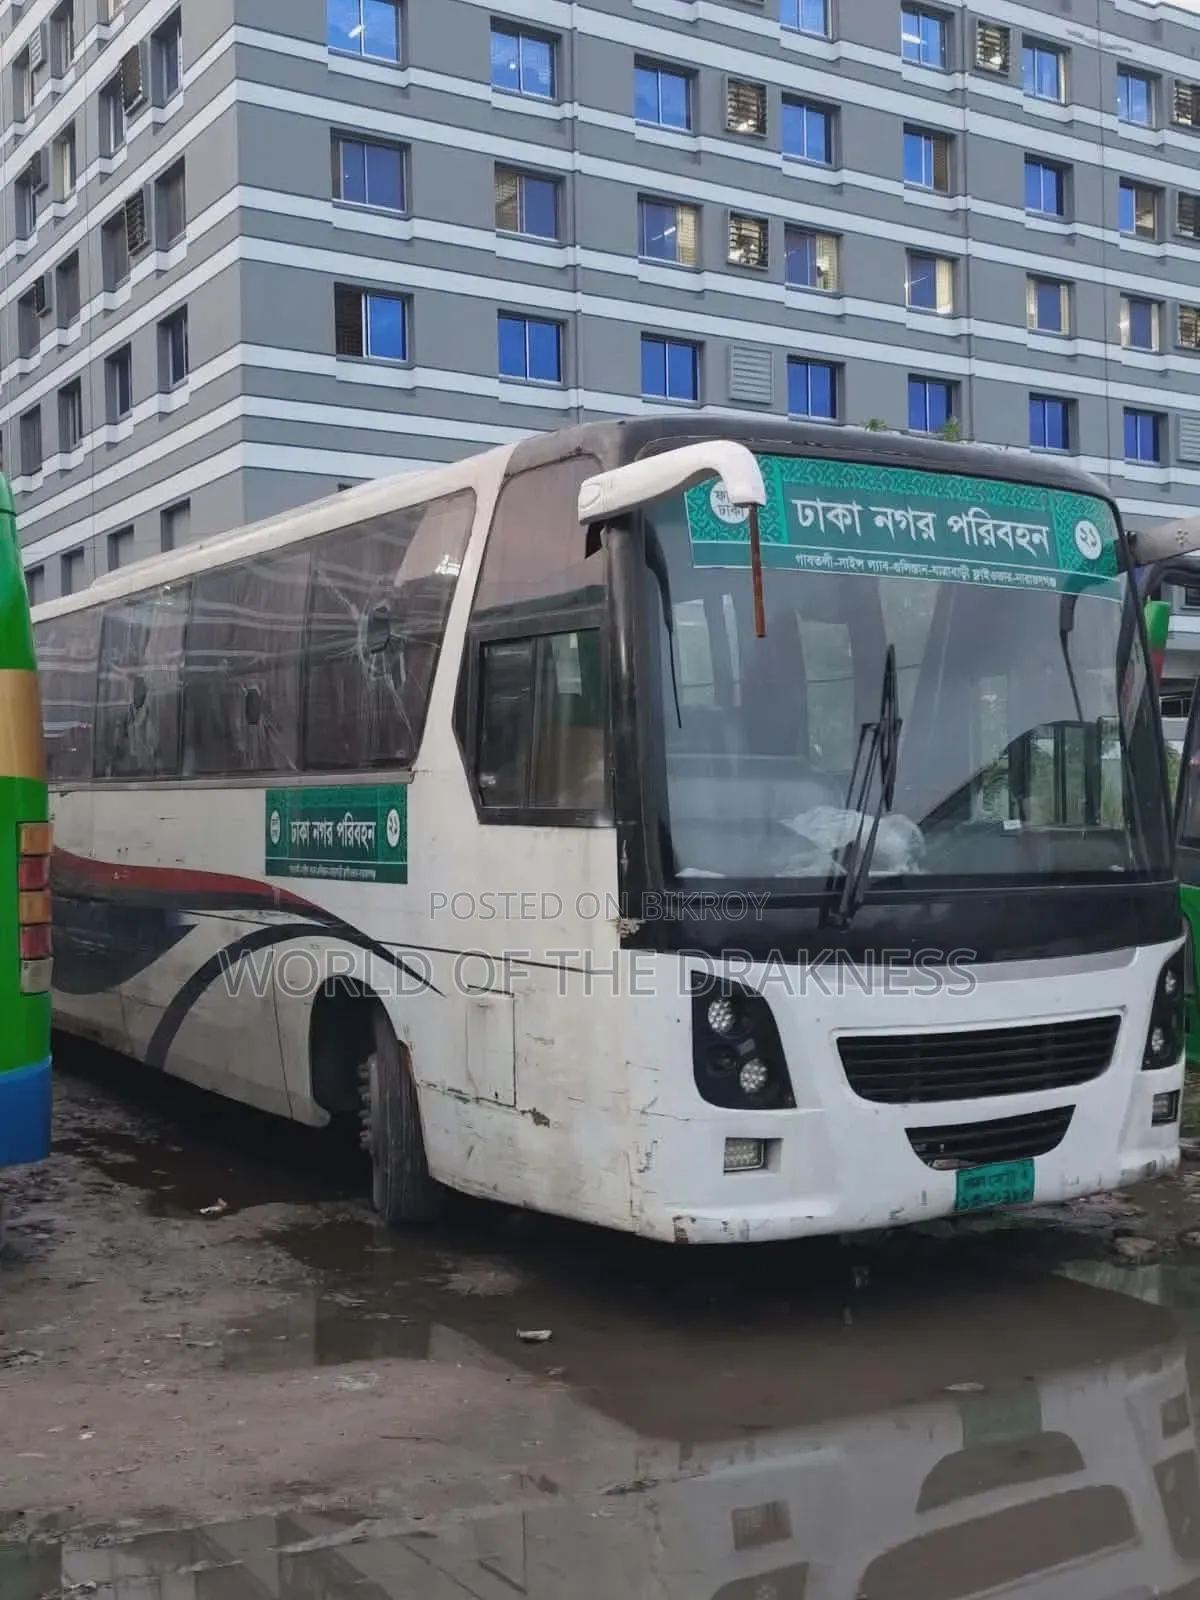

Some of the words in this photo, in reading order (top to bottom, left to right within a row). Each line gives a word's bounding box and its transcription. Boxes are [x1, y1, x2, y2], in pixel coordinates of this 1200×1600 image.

[789, 497, 863, 537] ঢাকা
[869, 504, 937, 543] নগর
[947, 507, 1050, 558] পরিবহন
[289, 818, 311, 849] ঢাকা
[311, 818, 335, 850] নগর
[336, 811, 377, 853] পরিবহন
